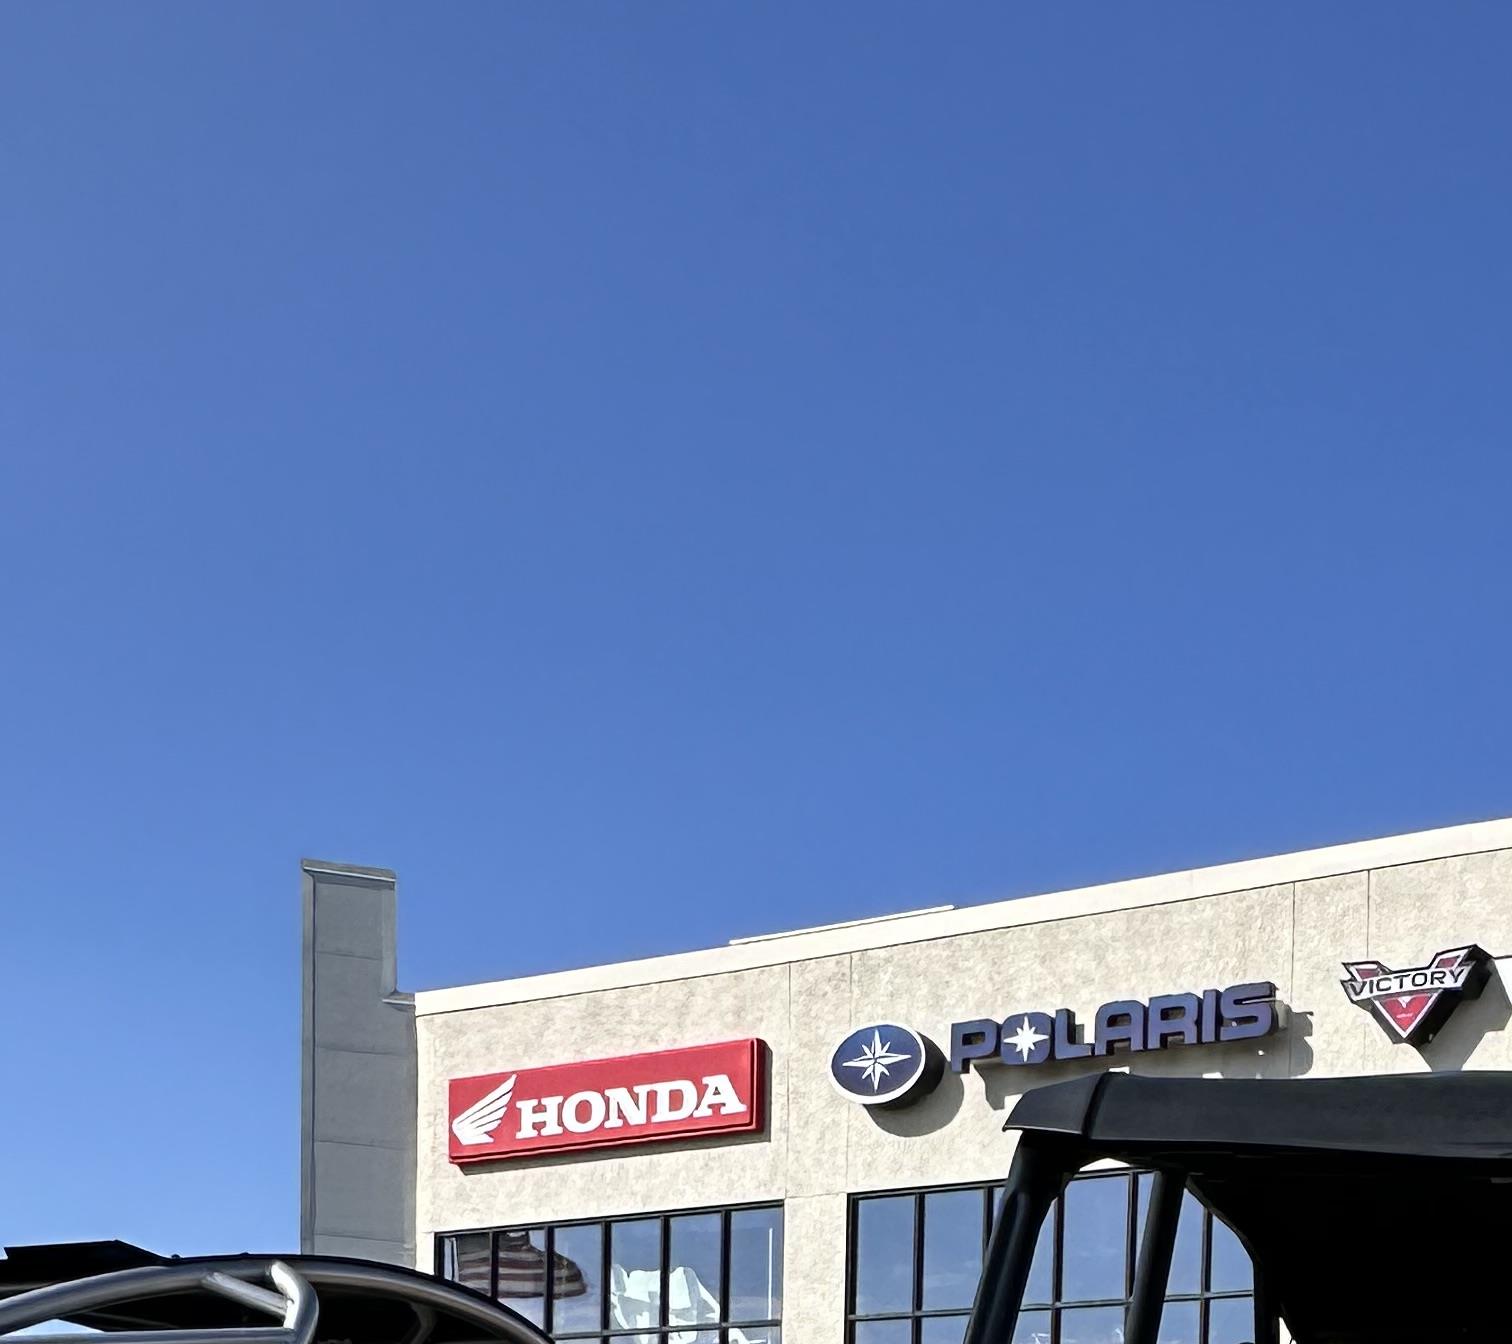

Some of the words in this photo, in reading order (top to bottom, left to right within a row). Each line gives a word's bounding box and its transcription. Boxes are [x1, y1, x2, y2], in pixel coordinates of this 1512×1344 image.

[1350, 968, 1465, 996] VICTORY
[950, 981, 1276, 1073] POLARIS
[515, 1074, 748, 1139] HONDA
